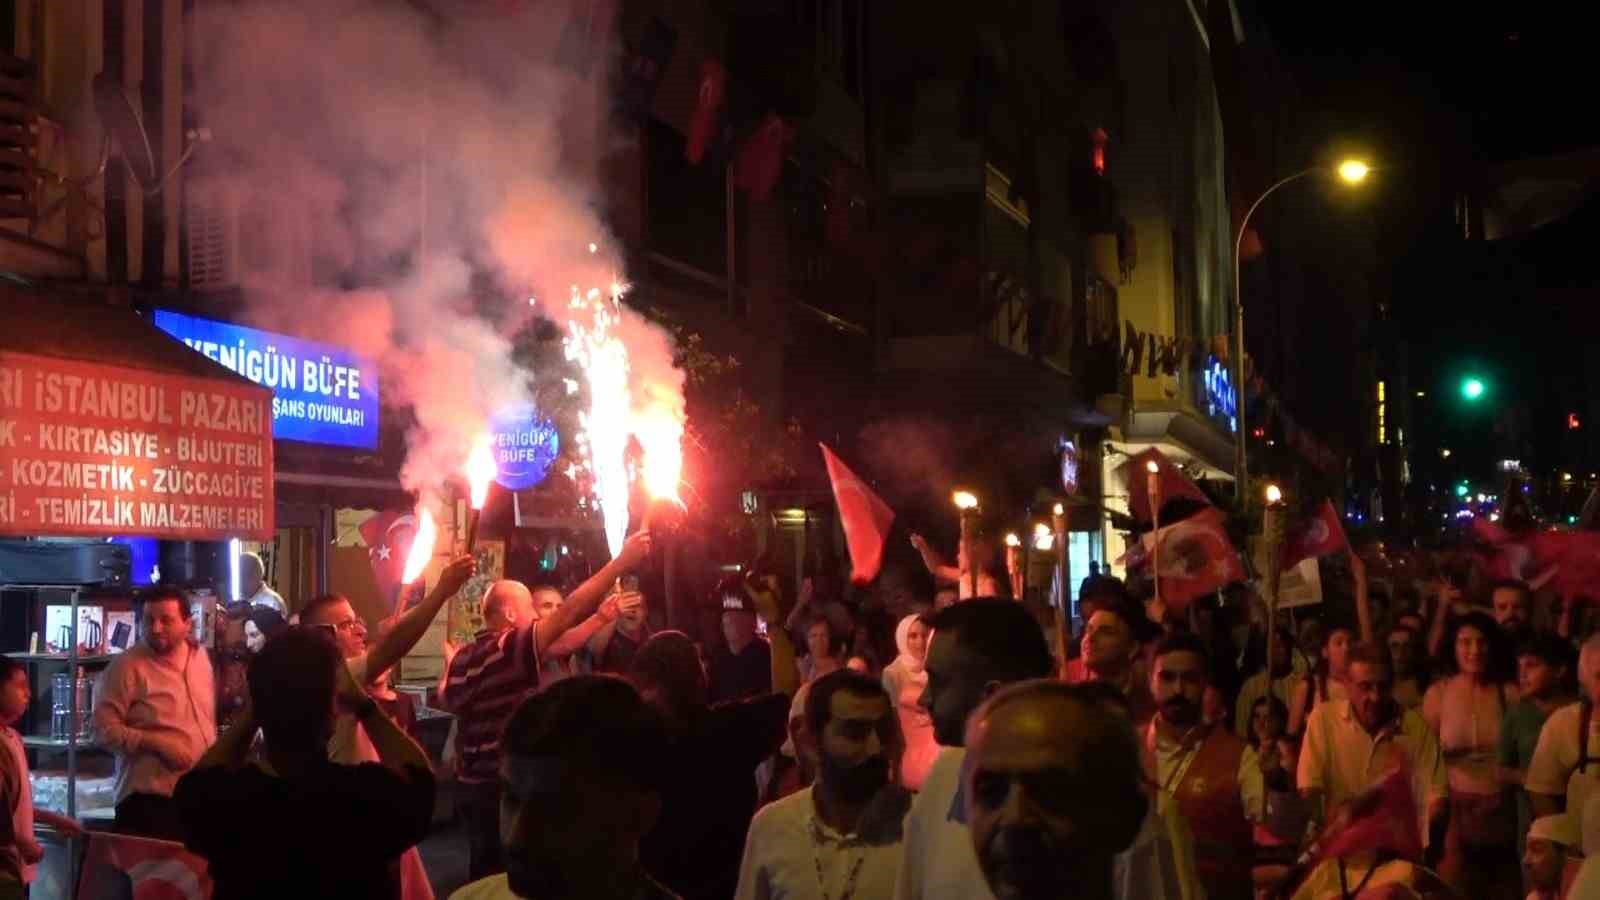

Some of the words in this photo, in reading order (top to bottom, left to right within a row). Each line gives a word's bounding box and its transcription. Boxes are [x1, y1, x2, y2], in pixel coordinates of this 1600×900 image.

[303, 355, 361, 400] BÜFE
[180, 388, 263, 434] PAZARI
[272, 398, 304, 420] ŞANS
[308, 403, 364, 428] OYUNLARI
[39, 421, 158, 459] KIRTASİYE
[177, 433, 263, 467] BİJUTERİ
[500, 447, 536, 462] BÜFE
[12, 457, 135, 492] KOZMETİK
[153, 464, 263, 499] ZÜCCACİYE
[35, 493, 135, 527] TEMİZLİK
[140, 502, 264, 530] MALZEMELERİ
